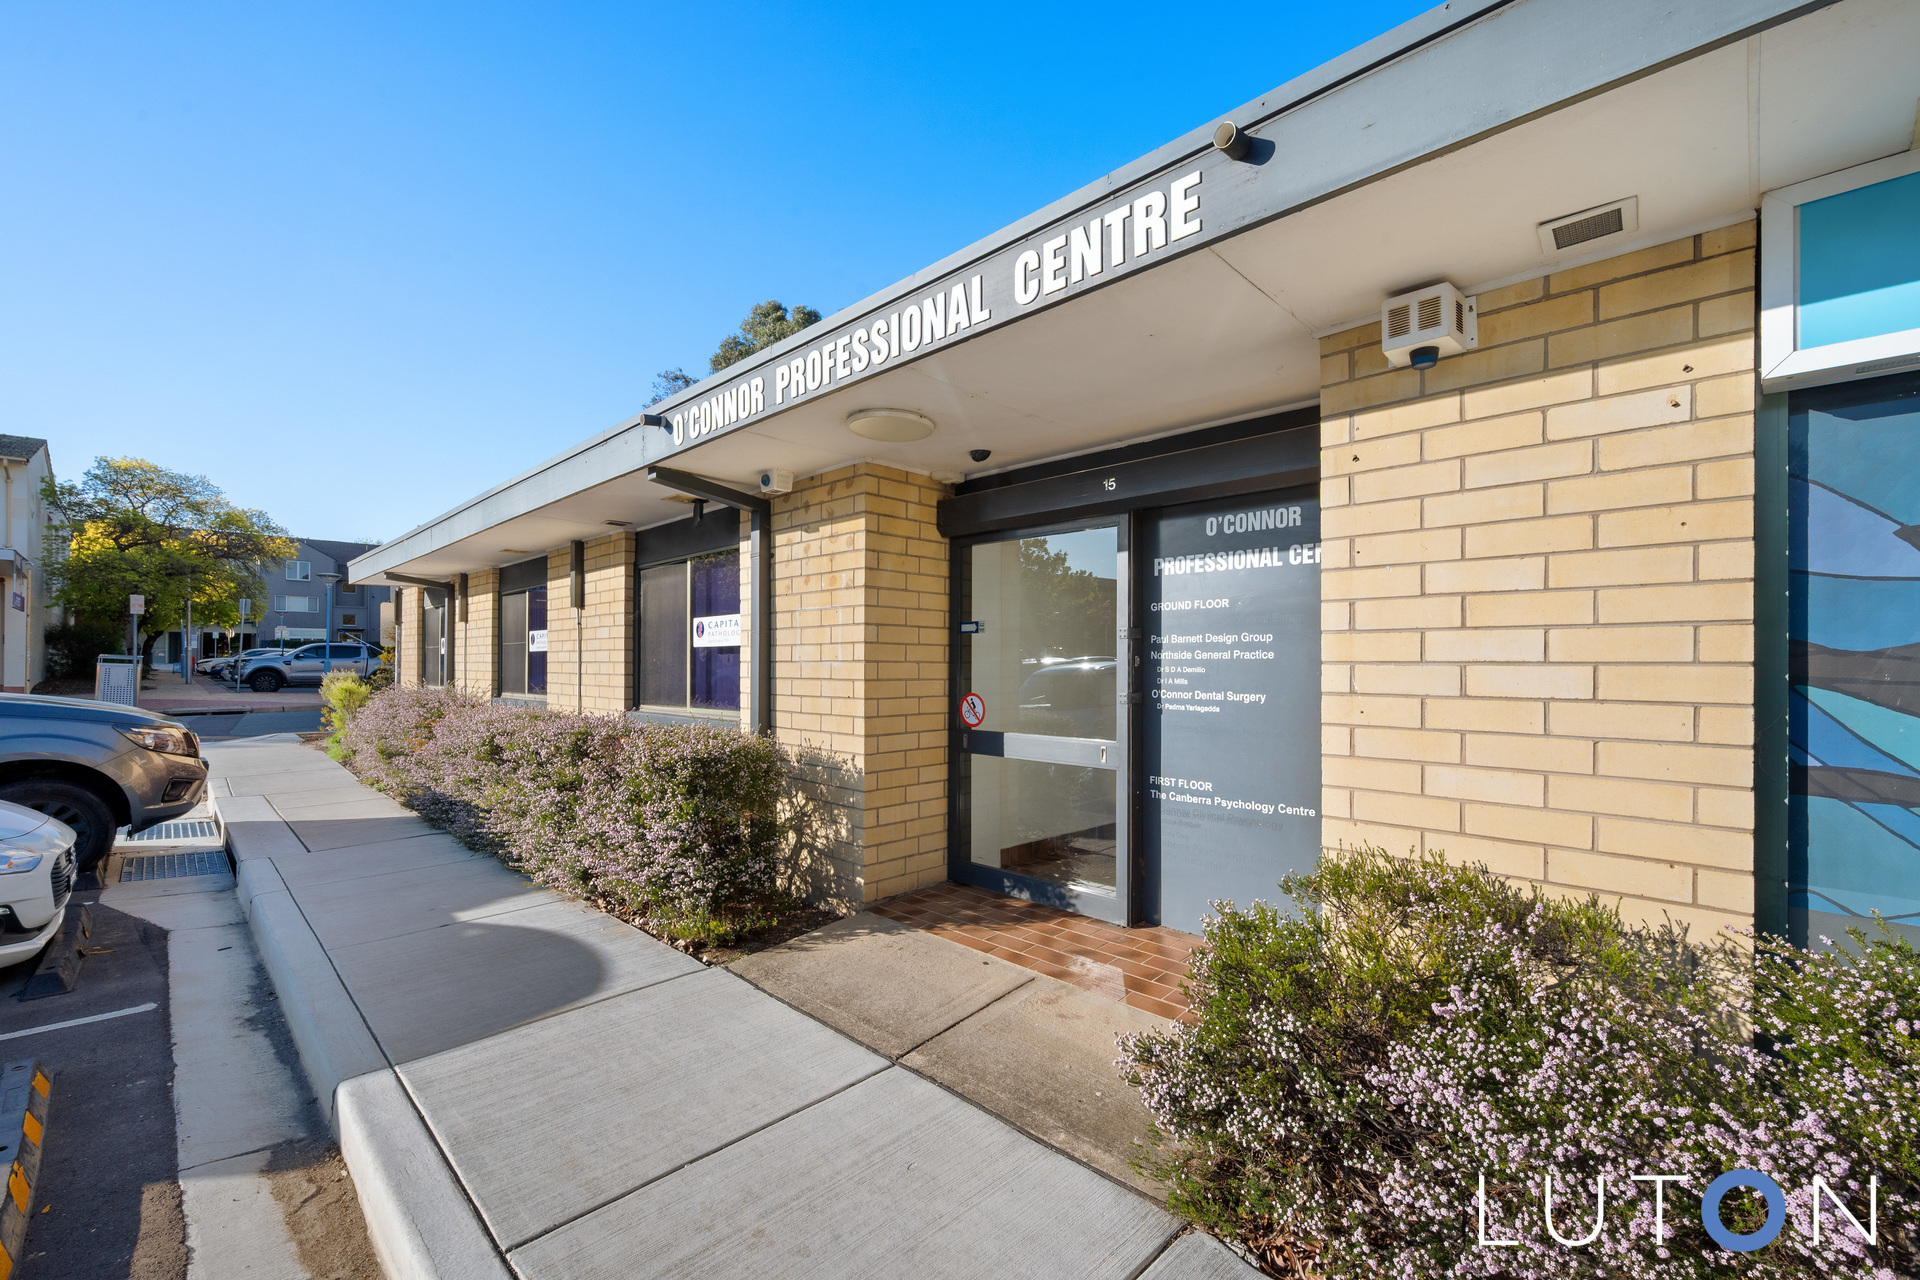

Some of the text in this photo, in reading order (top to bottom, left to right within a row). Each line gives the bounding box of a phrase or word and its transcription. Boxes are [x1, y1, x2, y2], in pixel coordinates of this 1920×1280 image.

[673, 170, 1202, 446] O'CONNOR PROFESSIONAL CENTRE
[1103, 478, 1116, 490] 15
[1206, 506, 1301, 536] O'CONNOR
[1154, 546, 1282, 576] PROFESSIONAL
[1150, 598, 1229, 611] GROUND FLOOR
[1150, 632, 1273, 645] Paul Barnett Design Group
[1150, 649, 1275, 660] Northside General Practice
[1151, 689, 1266, 704] O'Connor Dental Surgery
[1150, 775, 1213, 791] FIRST FLOOR
[1150, 789, 1316, 817] The Canberra Psychology Centre
